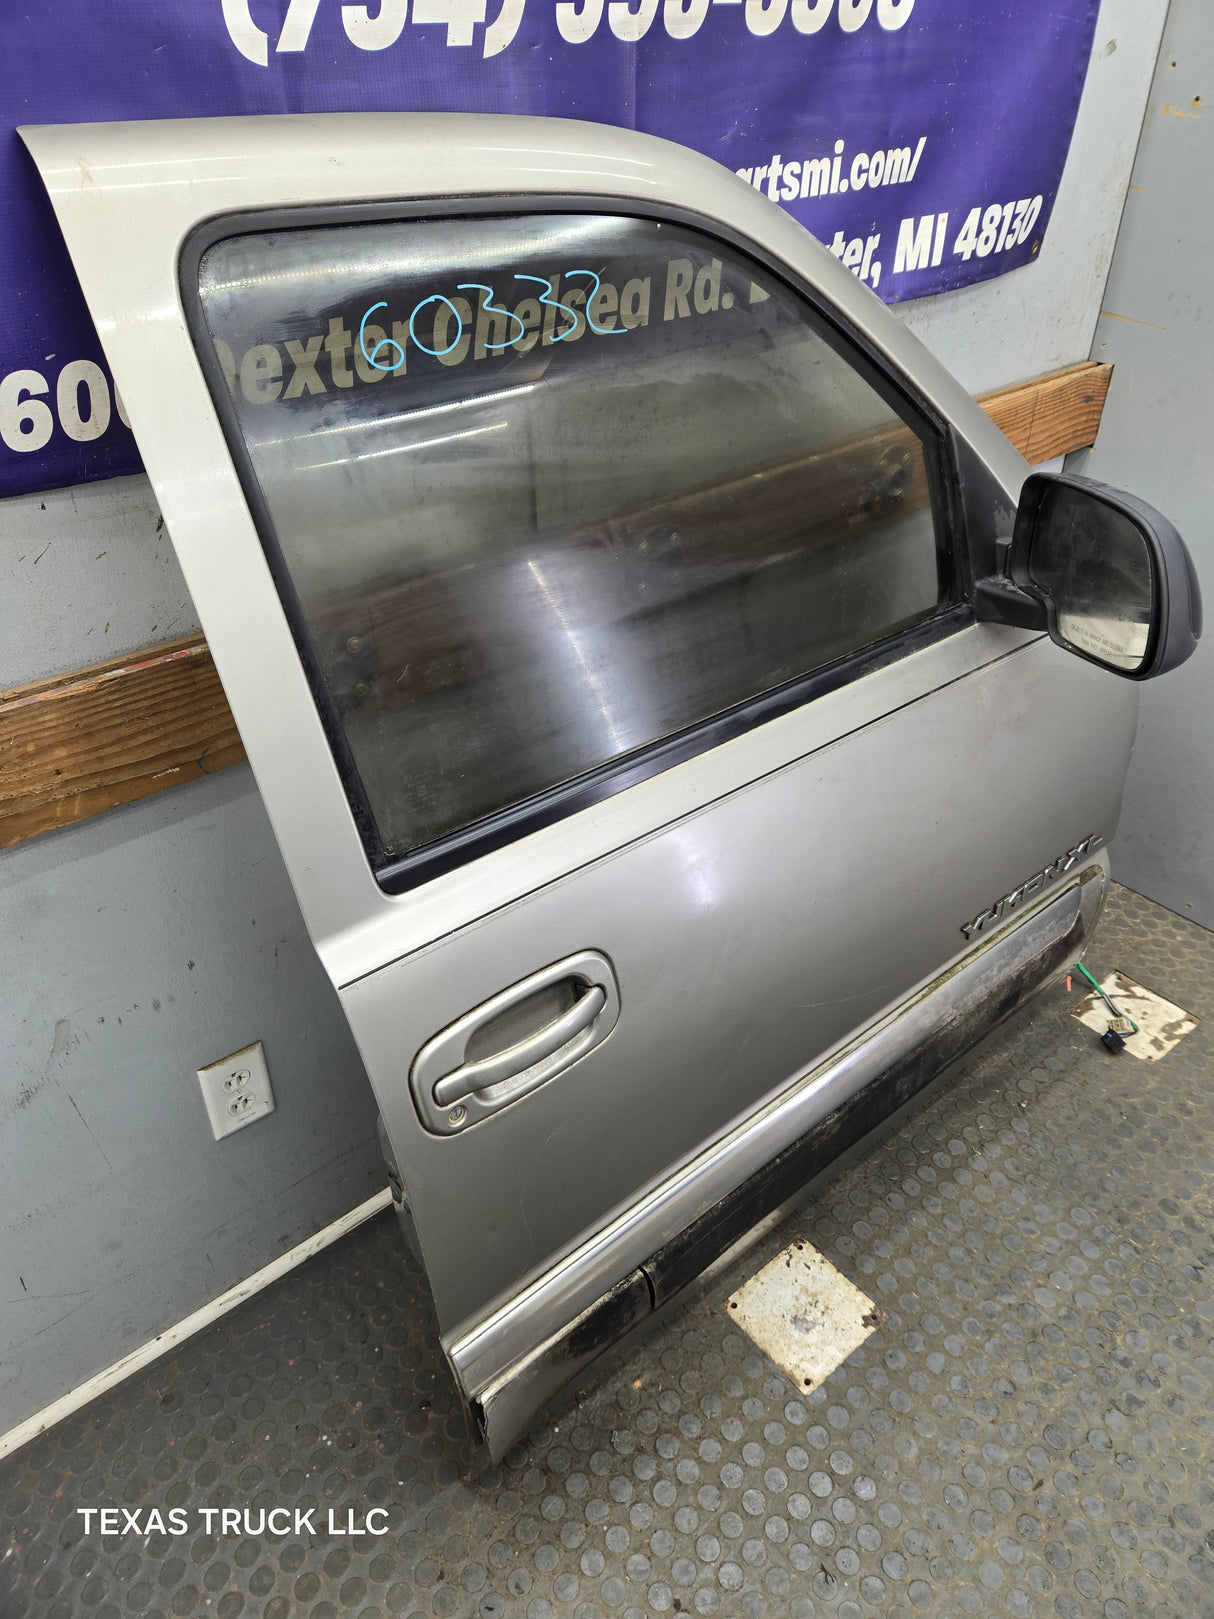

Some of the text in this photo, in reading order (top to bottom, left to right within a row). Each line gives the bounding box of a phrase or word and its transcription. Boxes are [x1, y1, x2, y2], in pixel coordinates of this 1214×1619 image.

[0, 359, 132, 453] 60
[432, 272, 651, 367] Chelsea
[663, 256, 735, 322] Rd.
[893, 212, 949, 274] MI
[953, 194, 1044, 262] 48130
